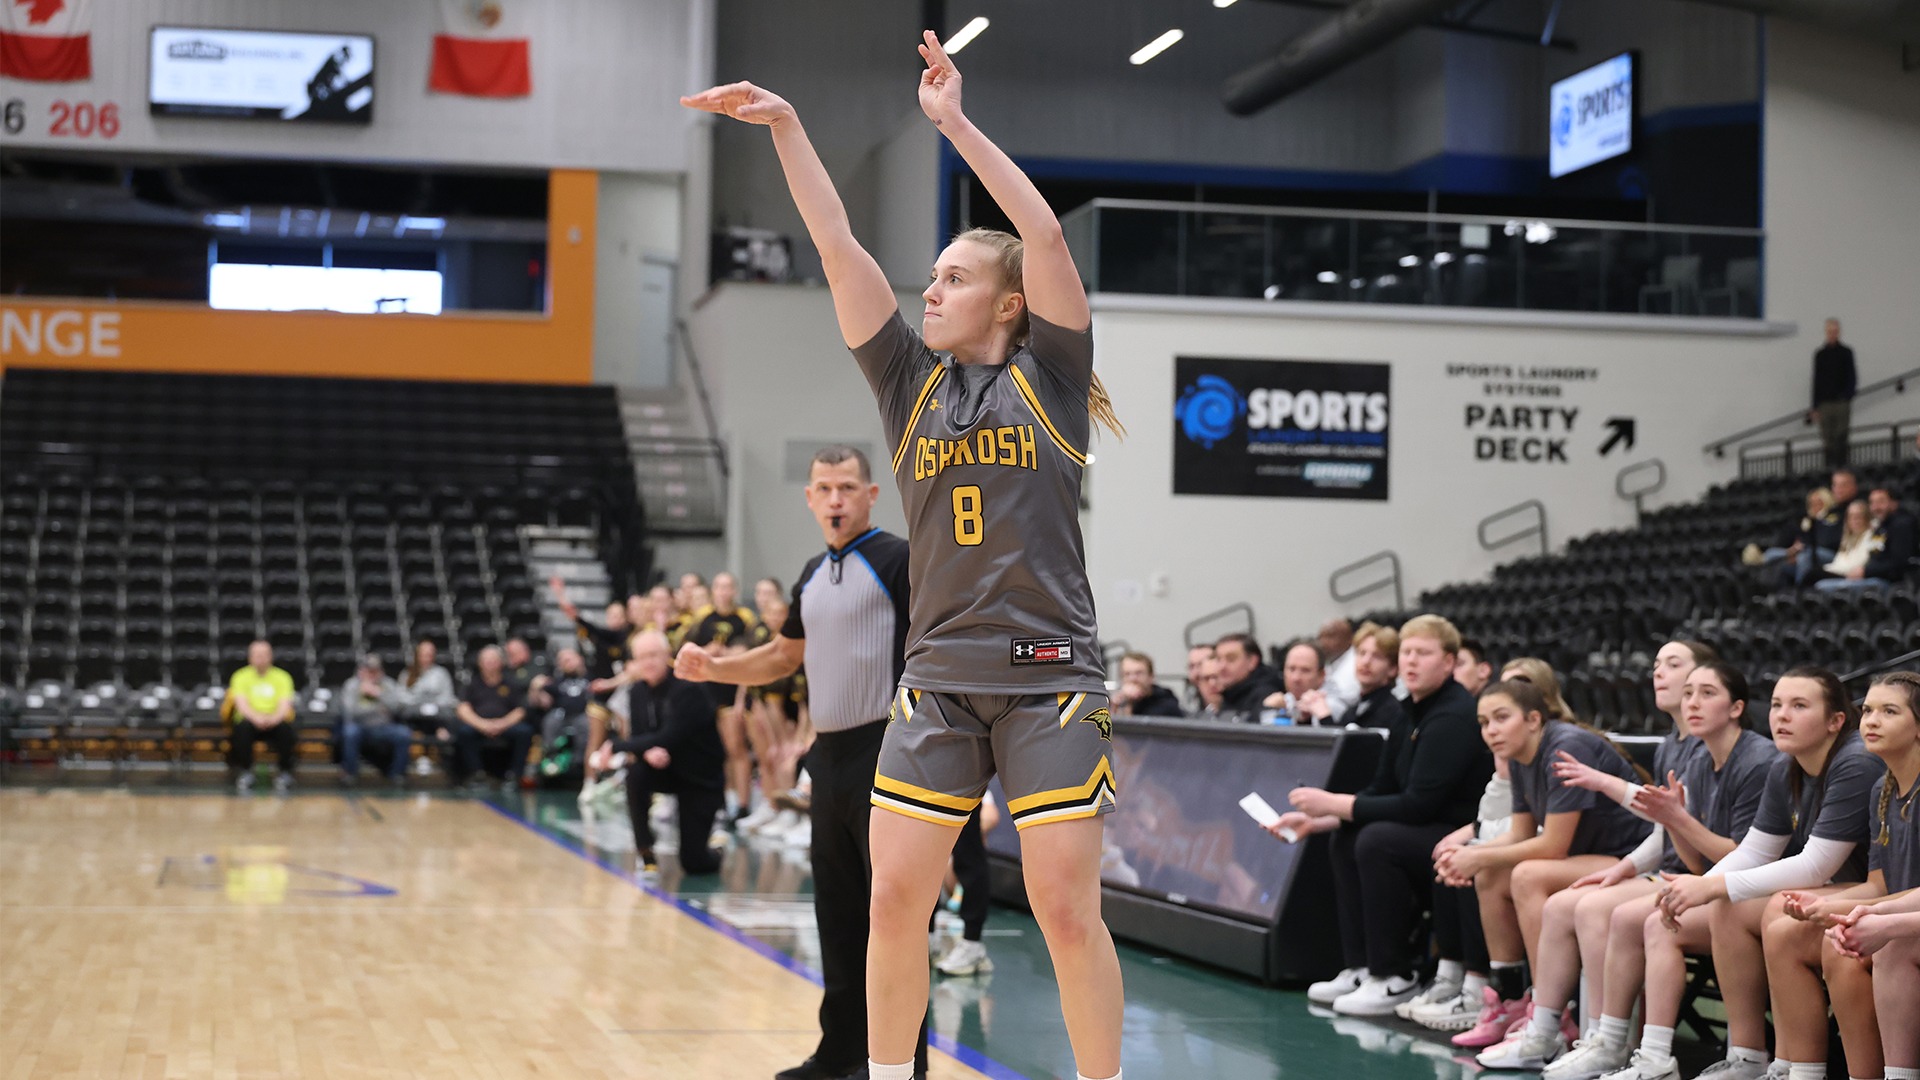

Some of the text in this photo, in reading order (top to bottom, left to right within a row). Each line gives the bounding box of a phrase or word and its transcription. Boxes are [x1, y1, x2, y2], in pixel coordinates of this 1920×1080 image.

[0, 99, 25, 134] 6
[49, 100, 120, 138] 206
[0, 309, 121, 357] NGE
[1446, 363, 1512, 379] SPORTS
[1248, 388, 1387, 432] SPORTS
[1464, 404, 1578, 431] PARTY
[914, 424, 1038, 482] OSHKOSH
[1475, 437, 1569, 464] DECK
[951, 484, 984, 546] 8
